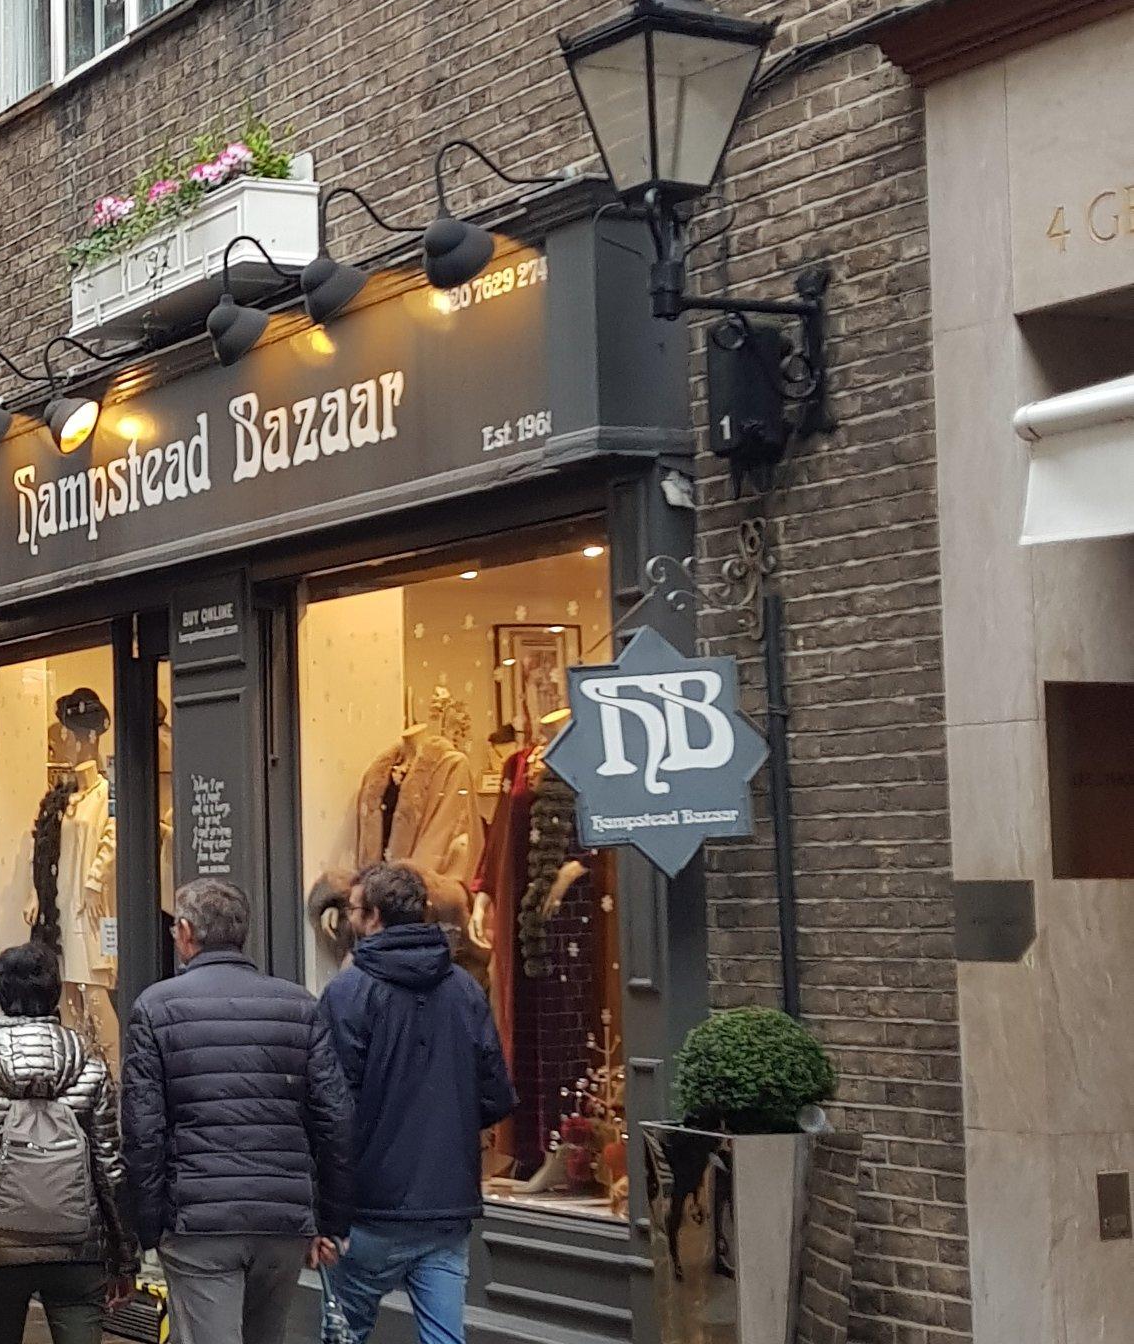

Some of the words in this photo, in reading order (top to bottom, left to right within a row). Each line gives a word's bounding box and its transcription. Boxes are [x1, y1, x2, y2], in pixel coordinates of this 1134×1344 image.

[1046, 206, 1071, 253] 4
[472, 266, 515, 304] 7629
[228, 370, 404, 484] Bazaar
[719, 415, 731, 440] 1
